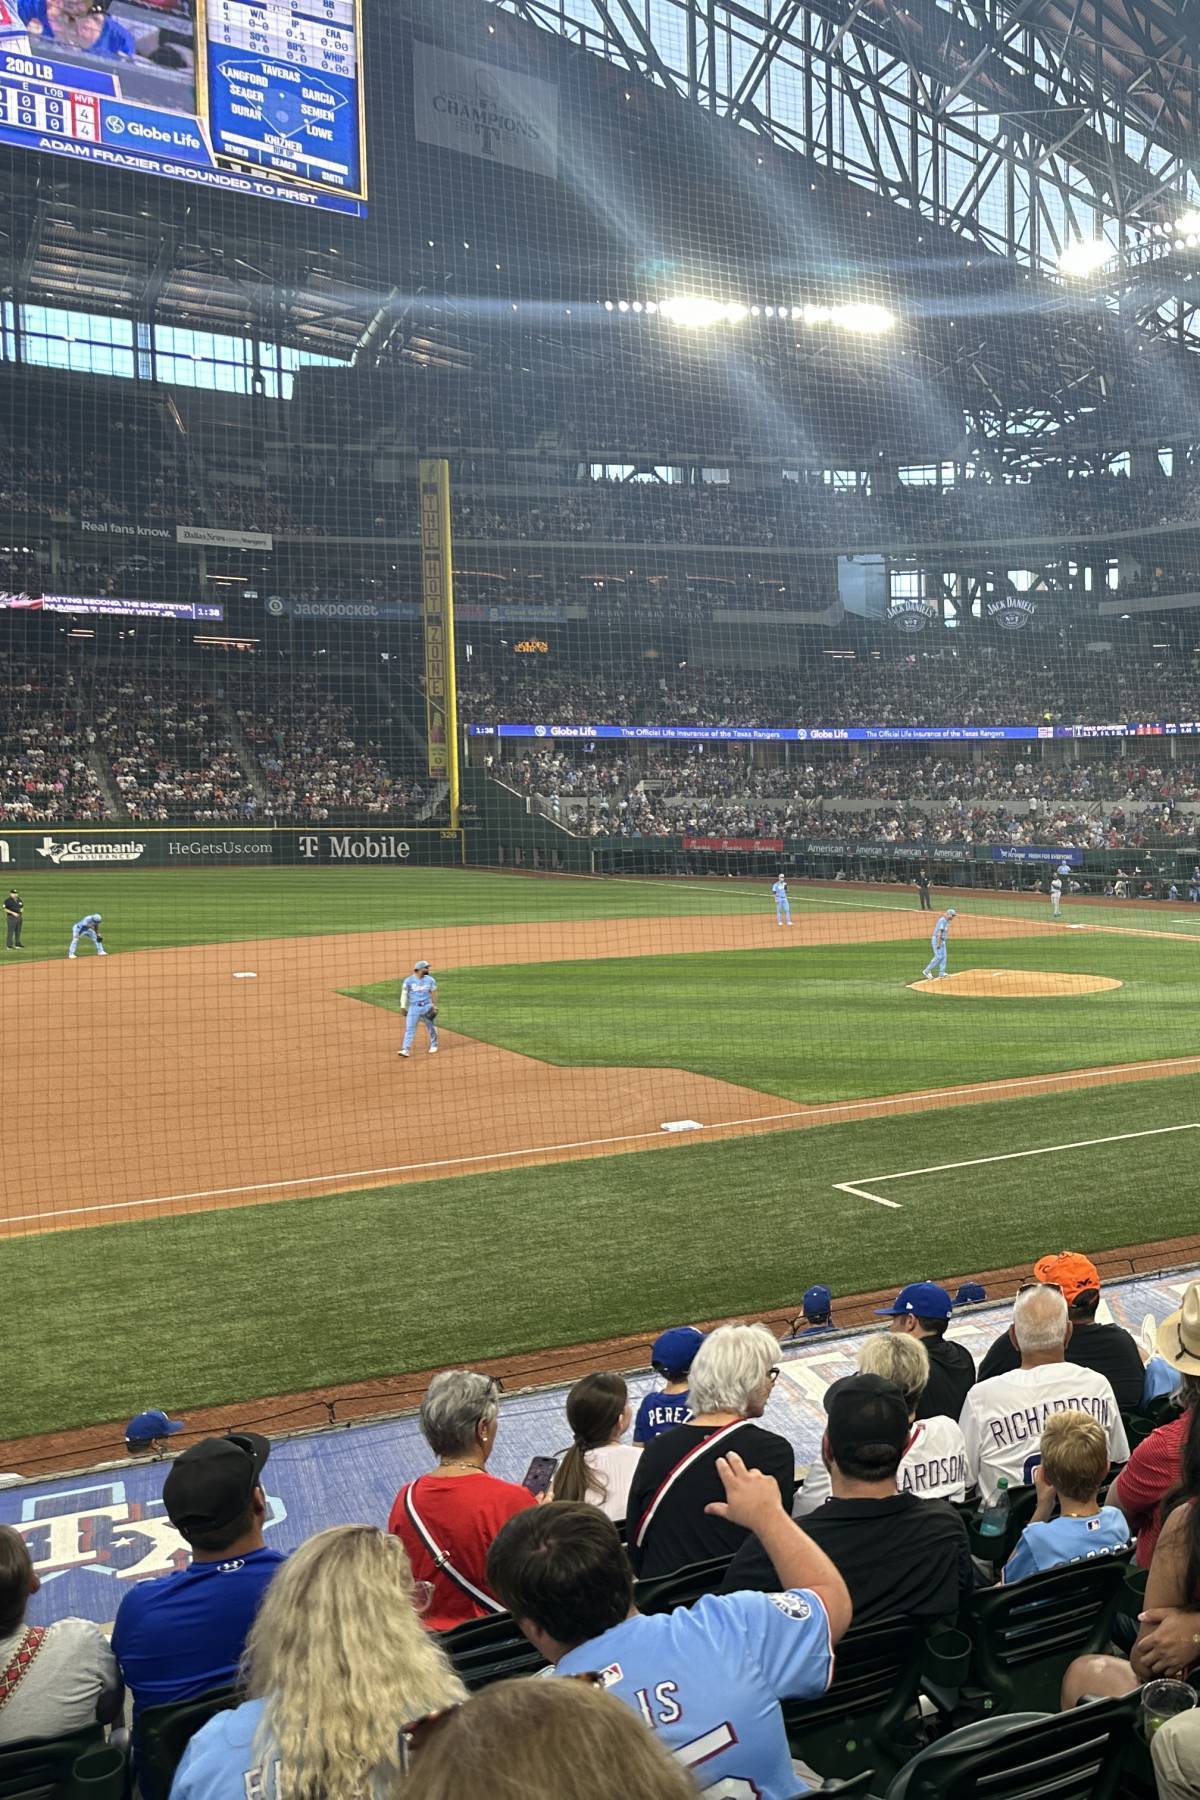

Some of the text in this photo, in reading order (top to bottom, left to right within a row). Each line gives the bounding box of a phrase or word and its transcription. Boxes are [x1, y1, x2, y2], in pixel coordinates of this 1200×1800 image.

[326, 29, 341, 40] ERA
[323, 51, 345, 63] WHIP
[6, 56, 53, 81] 200 LB
[261, 63, 301, 83] TAVERAS
[222, 66, 269, 87] LANGFORD
[23, 81, 29, 91] E
[44, 87, 64, 99] LOB
[229, 84, 264, 103] SEAGER
[302, 87, 336, 107] GARCIA
[22, 96, 31, 107] 0
[50, 101, 59, 113] 0
[23, 113, 31, 124] 0
[81, 108, 89, 119] 4
[231, 103, 262, 121] DURAN
[301, 104, 335, 122] SEMIEN
[432, 96, 541, 140] CHAMPIONS
[51, 119, 60, 130] 0
[81, 125, 90, 136] 4
[127, 121, 201, 149] Globe Life
[306, 123, 334, 142] LOWE
[264, 133, 303, 153] KNIZNER
[39, 138, 318, 204] ADAM FRAZIER GROUNDED TO FIRST
[82, 521, 171, 538] Real fans know.
[428, 563, 438, 612] HOT
[45, 604, 88, 612] NUMBER
[101, 607, 134, 615] BOBBY
[135, 608, 160, 616] WITT
[122, 601, 139, 609] THE
[887, 602, 904, 619] JACK
[988, 600, 1006, 616] JACK
[198, 608, 220, 617] 1:38
[430, 627, 442, 696] ZONE
[475, 727, 494, 735] 1:38
[551, 726, 597, 737] Globe Life
[621, 728, 634, 736] The
[636, 729, 661, 737] Official
[662, 729, 676, 737] Life
[676, 729, 709, 738] Insurance
[719, 730, 731, 738] the
[733, 730, 752, 738] Texas
[754, 731, 780, 739] Rangers
[811, 730, 848, 739] Globe Life
[962, 731, 978, 739] Texas
[980, 731, 1005, 739] Rangers
[440, 831, 457, 839] 326
[69, 841, 144, 854] Germania
[168, 841, 273, 855] HeGetsUs.com
[299, 836, 410, 858] T Mobile
[807, 844, 962, 858] American American American American
[648, 1407, 694, 1427] PEREZ
